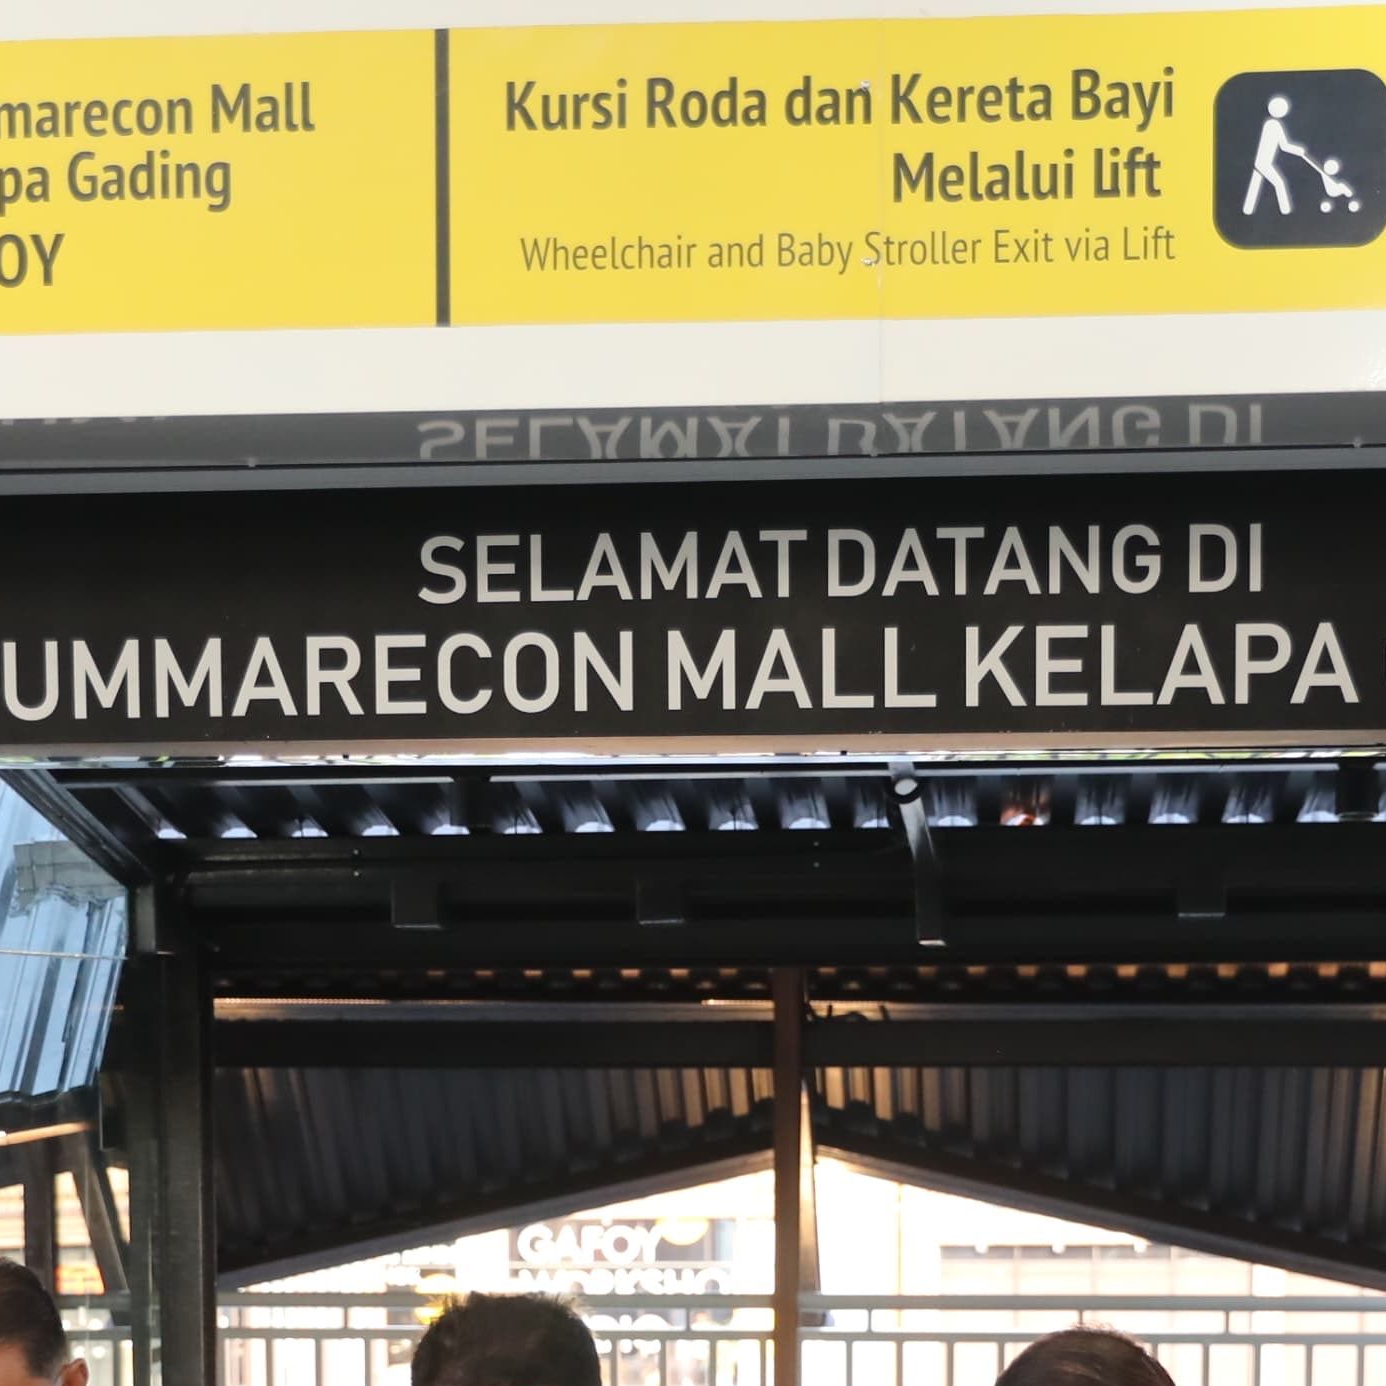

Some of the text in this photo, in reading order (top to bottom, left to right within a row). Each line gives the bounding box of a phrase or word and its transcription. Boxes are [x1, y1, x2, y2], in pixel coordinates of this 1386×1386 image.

[211, 81, 315, 133] Mall
[506, 66, 1174, 131] Kursi Roda dan Kereta Bayi
[67, 149, 231, 213] Gading
[893, 148, 1074, 203] Melalui
[520, 225, 1176, 275] Wheelchair and Baby Stroller Exit via Lift
[418, 523, 1262, 604] SELAMAT DATANG DI
[667, 626, 937, 711] MALL
[965, 622, 1359, 707] KELAPA
[517, 1224, 661, 1265] GAFOY
